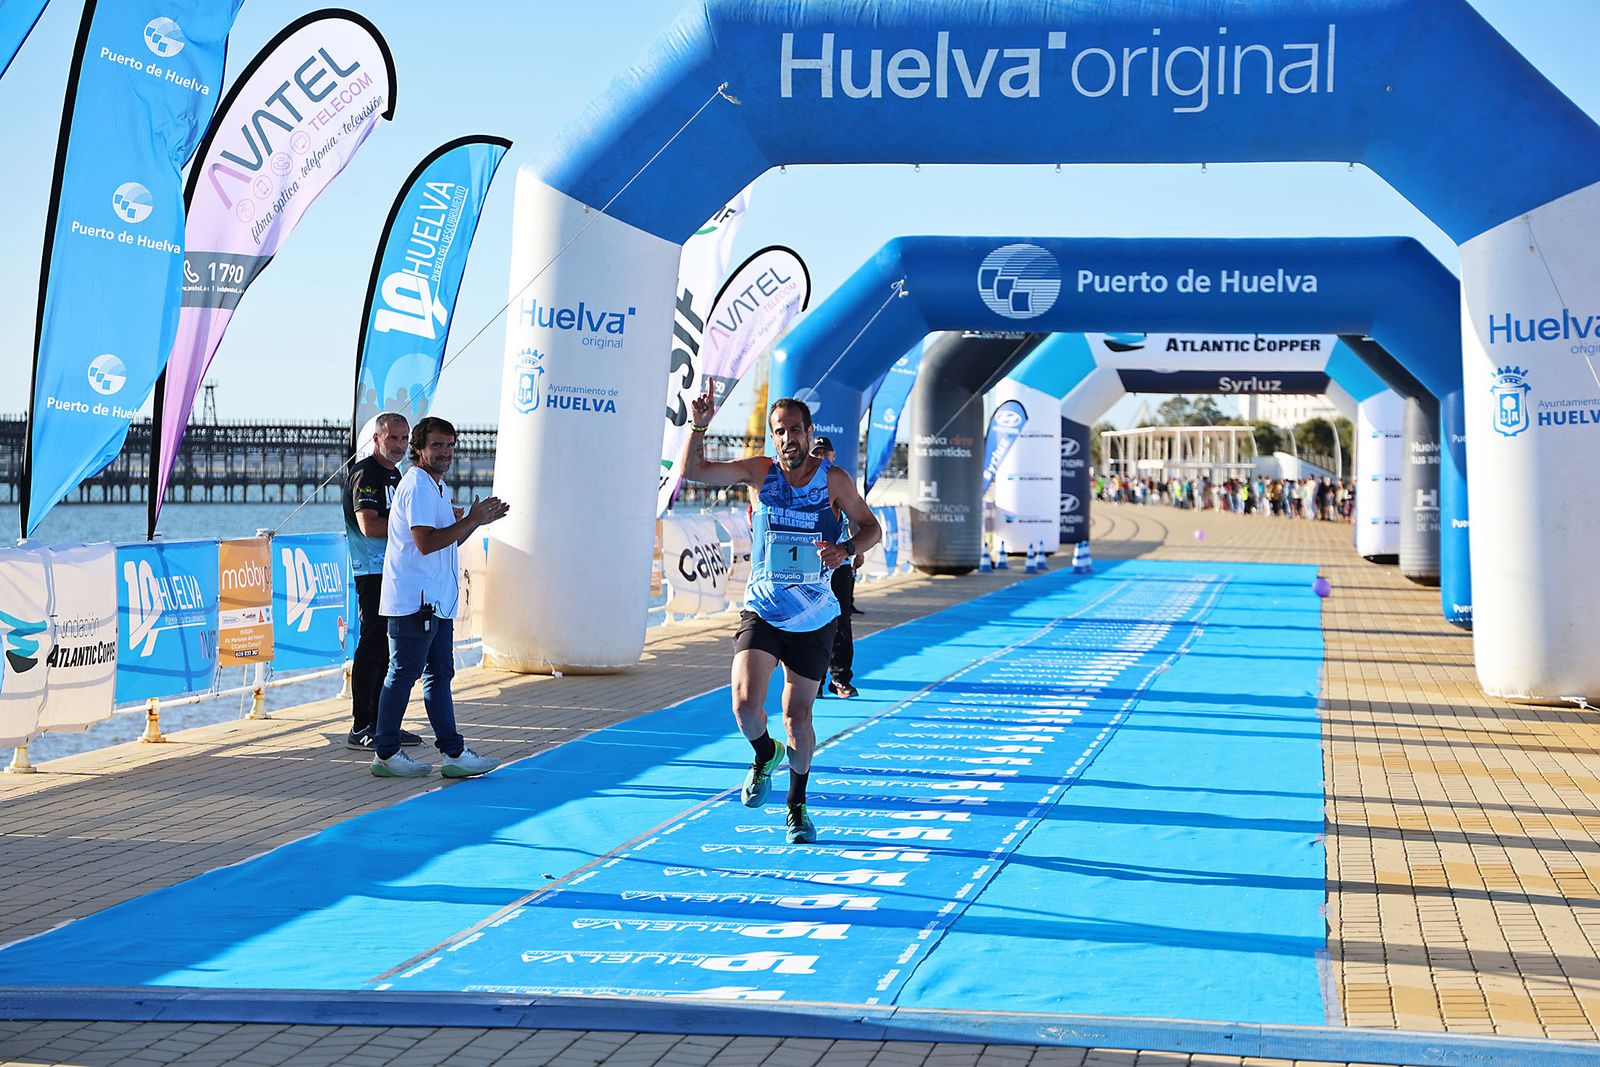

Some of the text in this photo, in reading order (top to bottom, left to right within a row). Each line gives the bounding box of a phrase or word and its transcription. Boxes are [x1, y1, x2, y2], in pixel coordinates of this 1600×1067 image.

[100, 47, 210, 95] Puerto de Huelva
[780, 24, 1336, 113] Huelva original
[308, 72, 374, 132] TELECOM
[208, 47, 360, 209] AVATEL
[251, 95, 385, 245] fibra óptica telefonía televisión
[71, 220, 182, 255] Puerto de Huelva
[401, 181, 455, 281] HUELVA
[431, 185, 466, 282] PUERTA DEL DESCUBRIMIENTO
[208, 262, 245, 284] 1790
[1077, 269, 1319, 294] Puerto de Huelva
[520, 298, 626, 334] Huelva
[709, 267, 792, 350] AVATEL
[1489, 308, 1600, 344] Huelv
[582, 335, 624, 350] original
[1166, 337, 1321, 352] ATLANTIC COPPER
[547, 383, 619, 397] Ayuntamiento de
[1218, 377, 1282, 394] Syrluz
[46, 397, 89, 414] Puerto
[92, 402, 109, 417] de
[546, 394, 617, 414] HUELVA
[813, 423, 844, 434] Huelva
[928, 446, 972, 457] sentidos
[767, 506, 819, 522] CLUB ONUBENSE
[770, 515, 815, 530] DE ATLETISMO
[930, 513, 966, 522] HUELVA
[788, 546, 798, 561] 1
[310, 562, 343, 593] HUELVA
[156, 576, 205, 612] HUELVA
[46, 644, 98, 668] ATLANTIC
[816, 779, 933, 788] HUELVA
[701, 843, 847, 857] HUELVA
[663, 866, 817, 880] HUELVA
[620, 890, 781, 905] HUELVA
[571, 918, 750, 933] HUELVA
[520, 952, 709, 967] HUELVA
